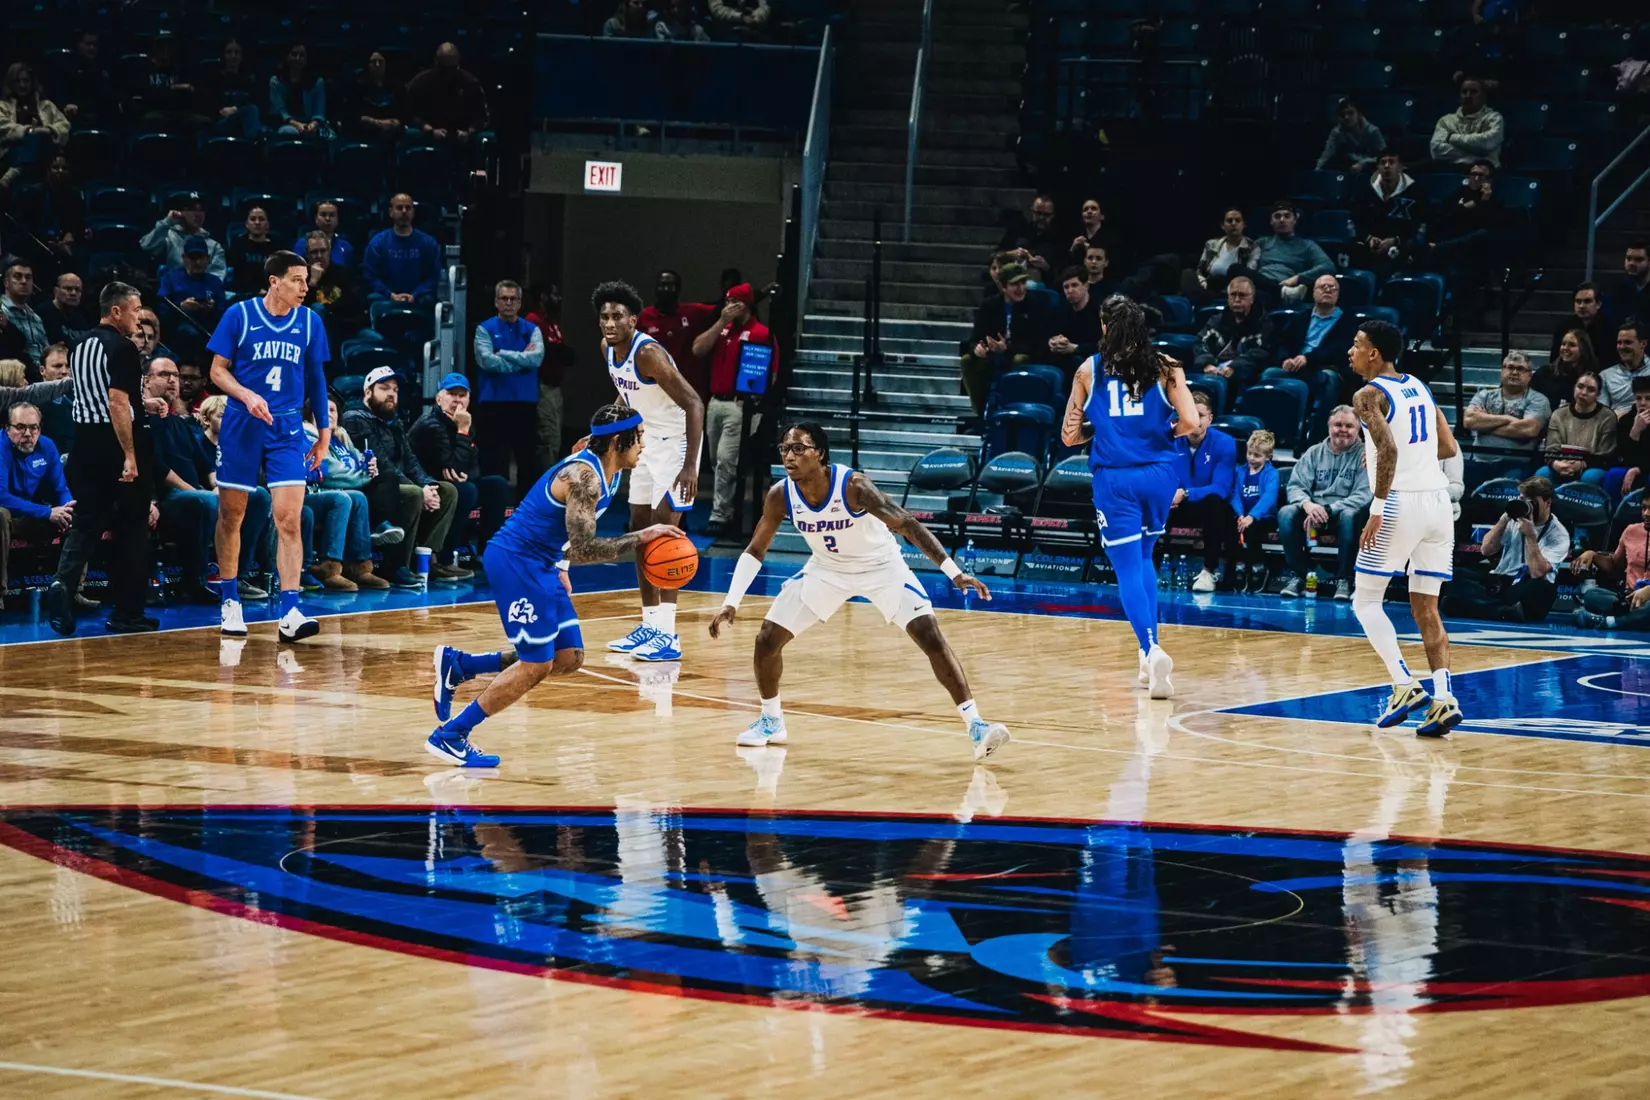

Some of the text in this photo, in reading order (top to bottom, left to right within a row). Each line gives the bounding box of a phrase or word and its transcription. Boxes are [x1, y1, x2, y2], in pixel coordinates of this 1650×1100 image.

[590, 165, 616, 186] EXIT
[252, 341, 301, 364] XAVIER
[265, 366, 282, 391] 4
[1107, 380, 1144, 417] 12
[1408, 404, 1428, 444] 11
[1564, 497, 1595, 505] AVIATION
[823, 535, 839, 553] 2
[1034, 563, 1070, 571] AVIATION
